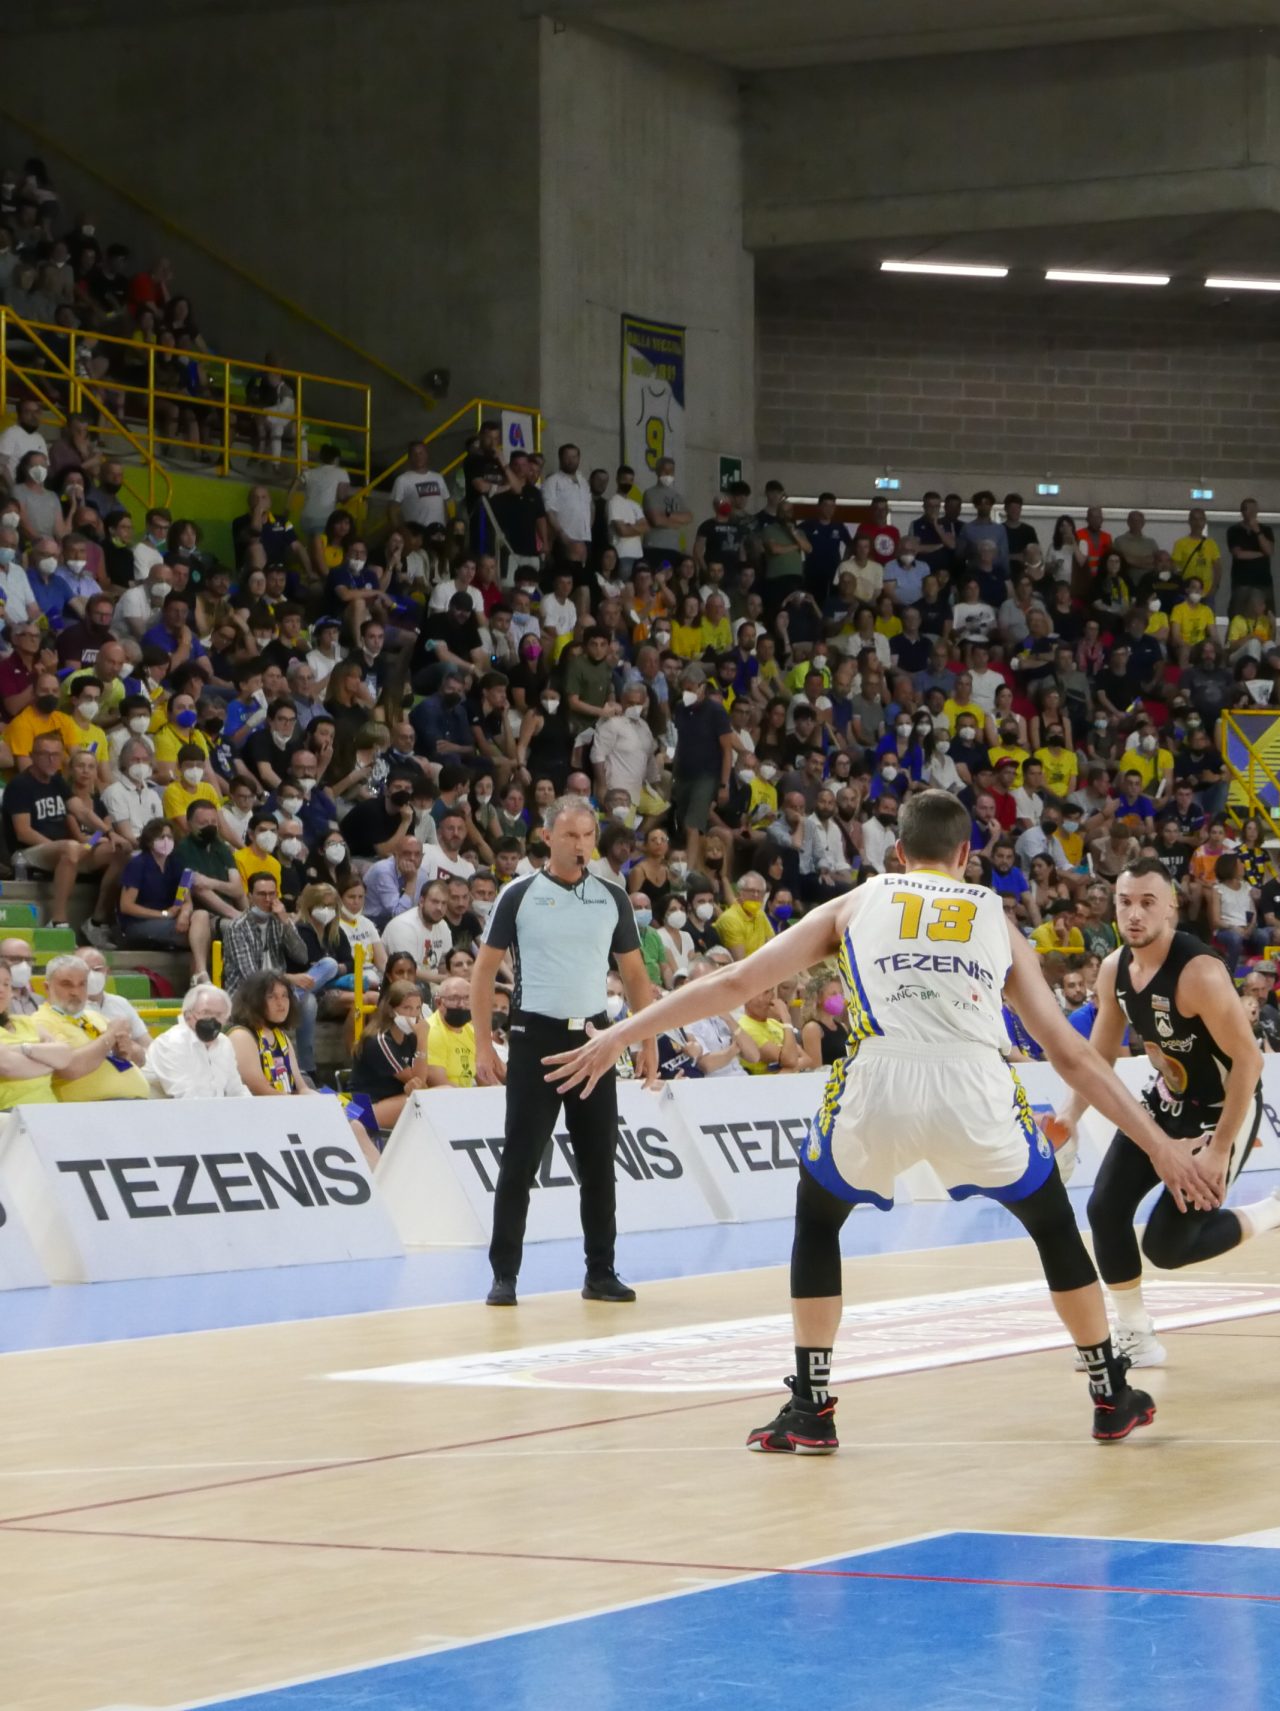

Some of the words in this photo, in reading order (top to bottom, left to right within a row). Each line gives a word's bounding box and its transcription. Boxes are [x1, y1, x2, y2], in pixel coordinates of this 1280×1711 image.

[645, 416, 666, 471] 9
[35, 795, 67, 820] USA
[891, 892, 978, 943] 13
[56, 1133, 373, 1222] TEZENIS
